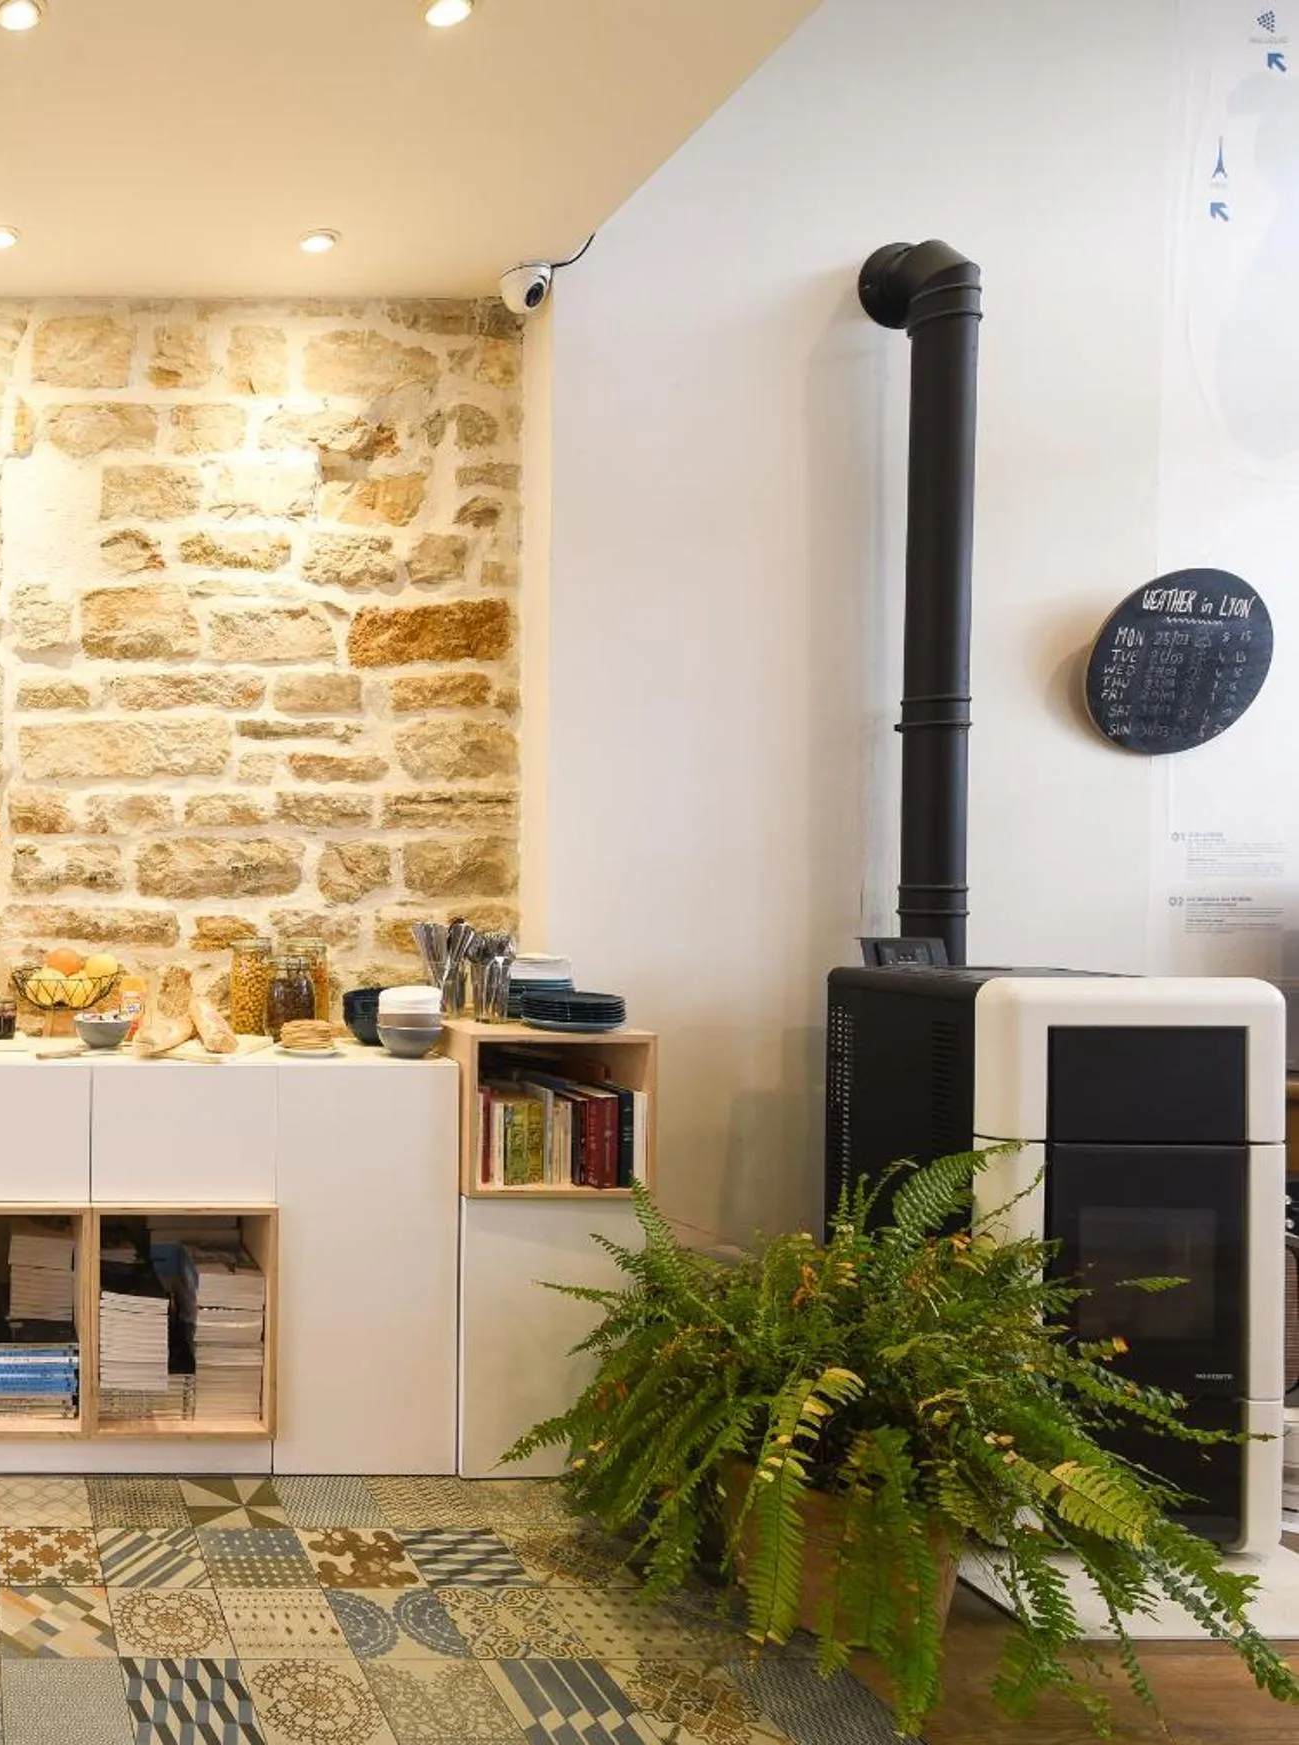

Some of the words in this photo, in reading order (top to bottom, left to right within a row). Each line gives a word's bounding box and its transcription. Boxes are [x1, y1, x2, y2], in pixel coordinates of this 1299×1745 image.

[1143, 588, 1197, 613] WEATHER
[1201, 597, 1213, 614] in
[1219, 594, 1257, 619] LYON
[1114, 626, 1146, 647] MON
[1111, 649, 1137, 663] TUE
[1104, 663, 1137, 677] WED
[1102, 676, 1130, 689] THU
[1101, 689, 1124, 701] FRI
[1108, 704, 1132, 718] SAT
[1108, 721, 1132, 736] SUN
